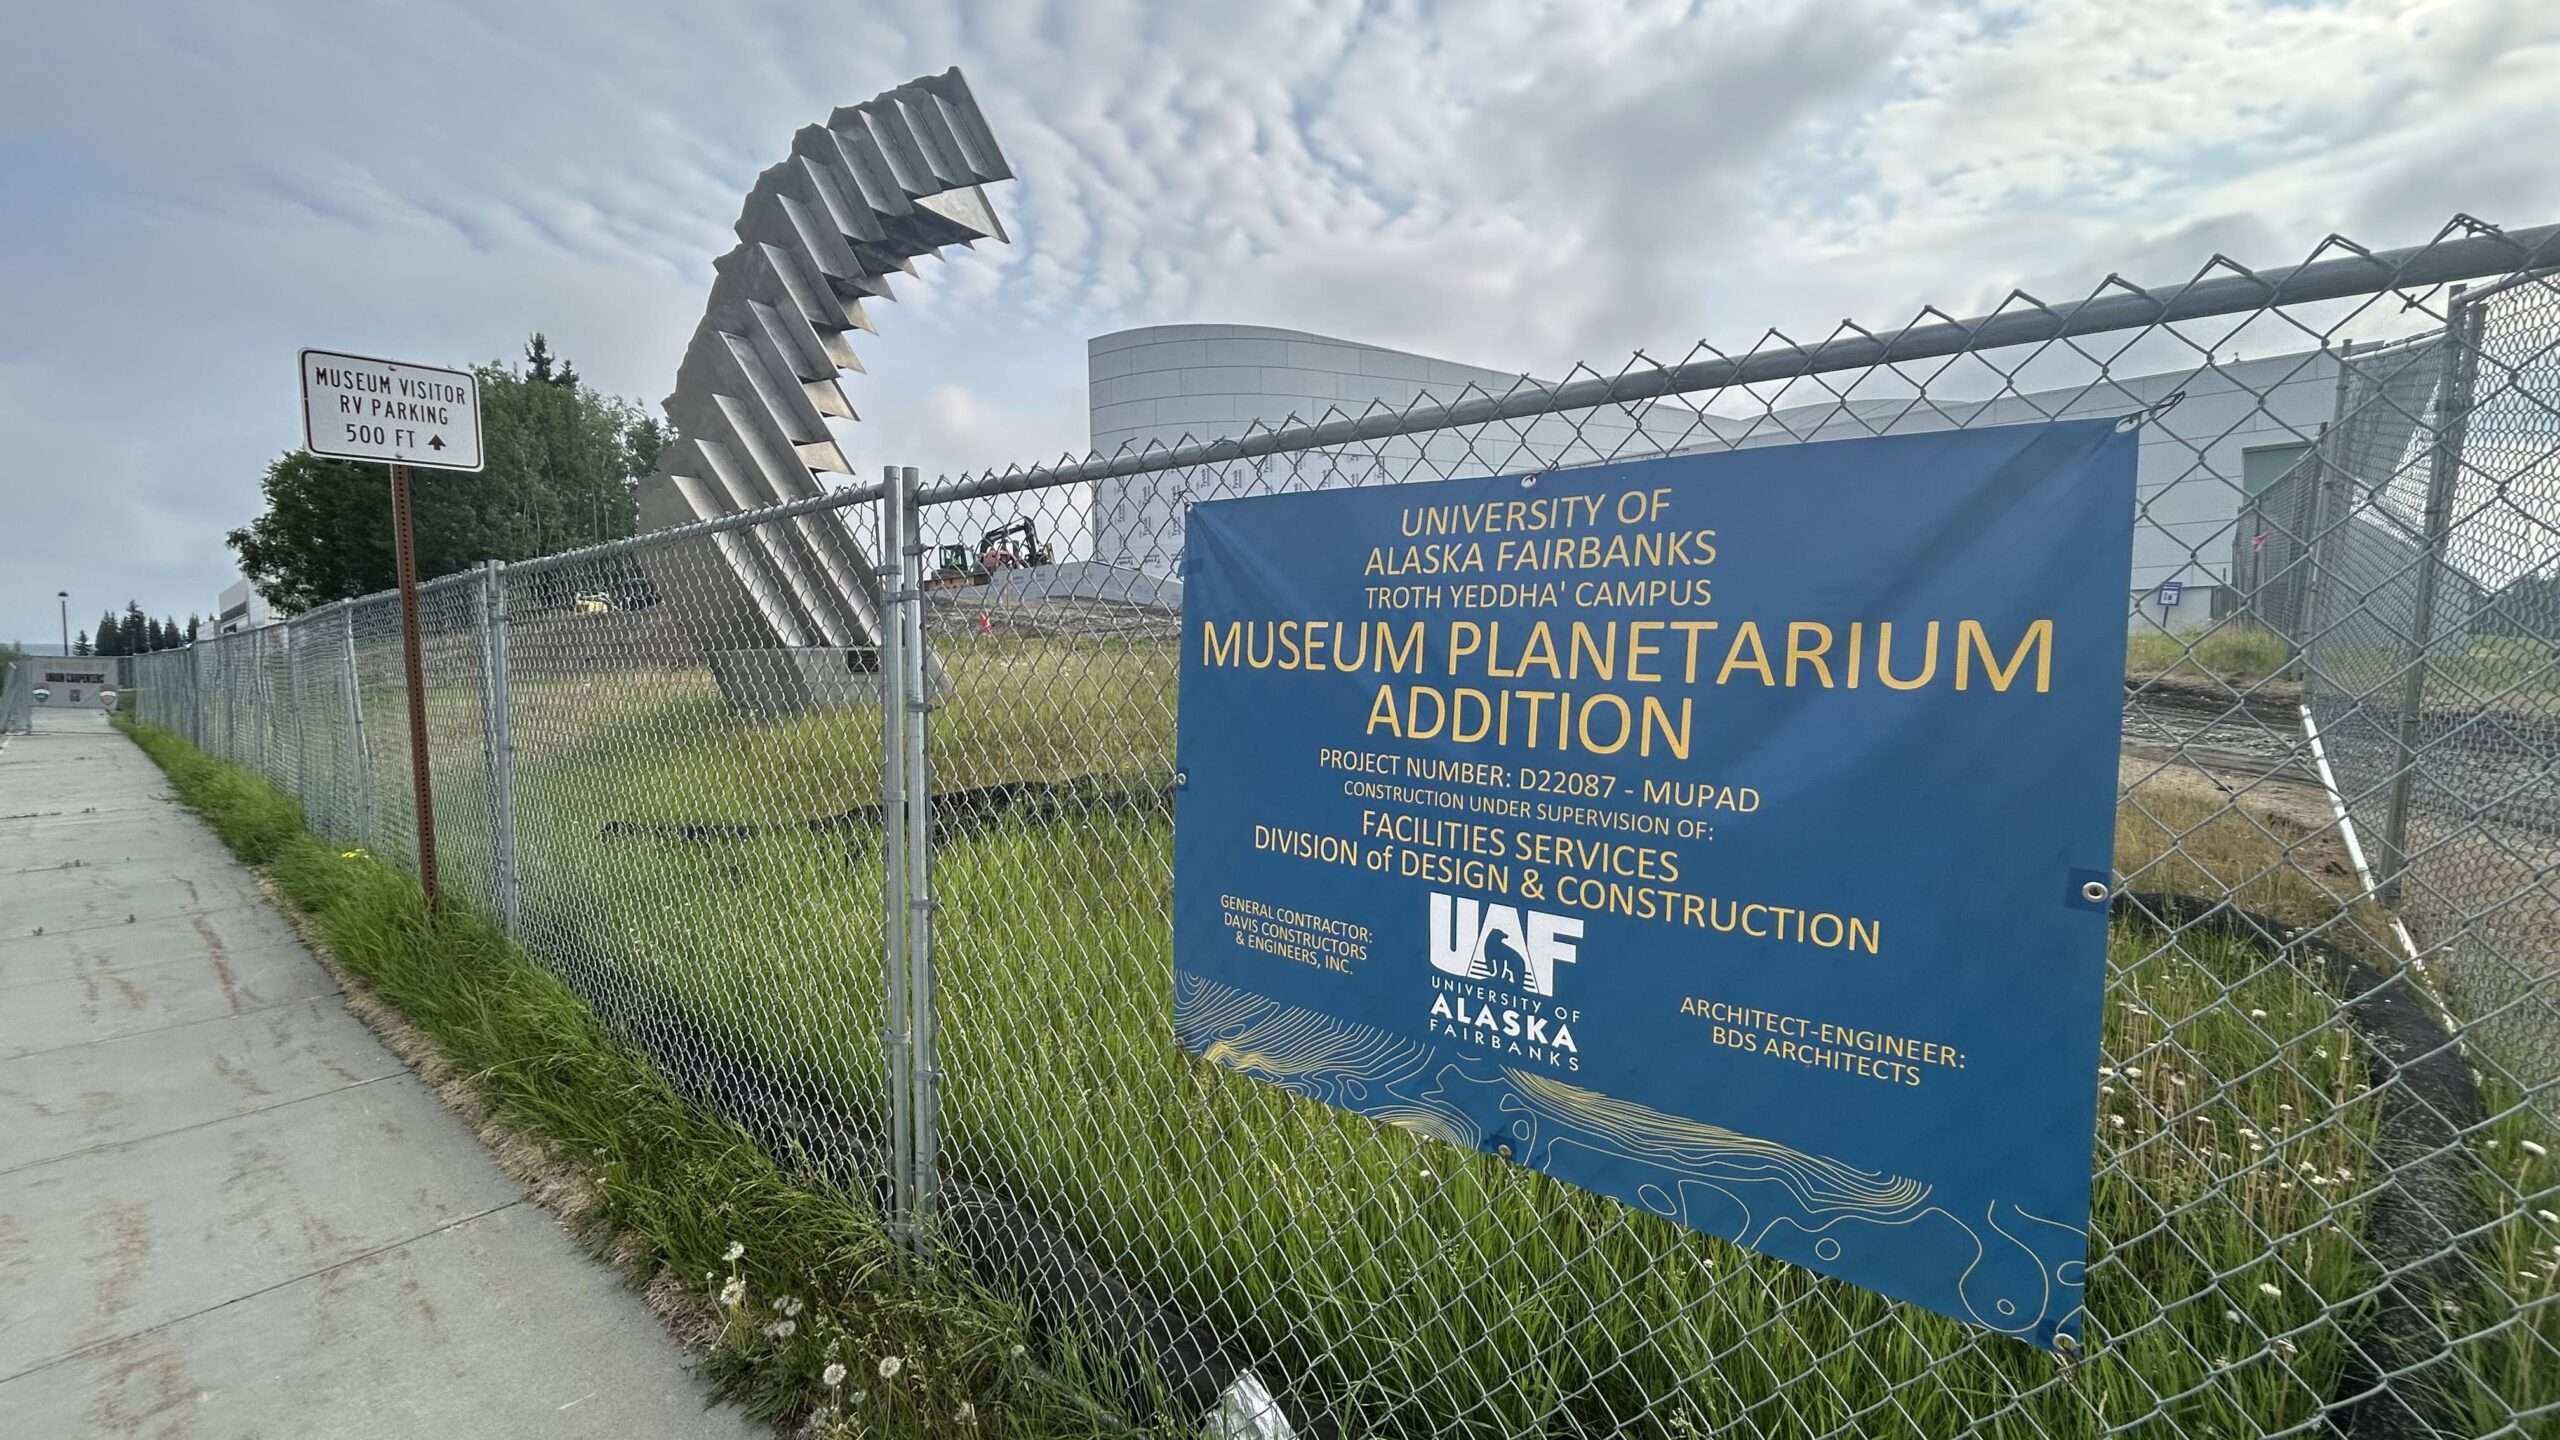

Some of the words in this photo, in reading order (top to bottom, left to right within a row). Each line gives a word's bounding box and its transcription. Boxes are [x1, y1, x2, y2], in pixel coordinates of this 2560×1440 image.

[315, 366, 391, 394] MUSEUM
[399, 379, 466, 405] VISITOR
[340, 395, 362, 415] RV
[372, 399, 448, 425] PARKING
[346, 423, 385, 445] 500
[396, 429, 416, 448] FT
[1402, 494, 1605, 537] UNIVERSITY
[1617, 488, 1672, 524] OF
[1364, 542, 1485, 576] ALASKA
[1497, 530, 1717, 571] FAIRBANKS
[1365, 586, 1440, 608] TROTH
[1450, 580, 1567, 608] YEDDHA'
[1575, 579, 1712, 606] CAMPUS
[1203, 621, 1425, 674] MUSEUM
[1449, 619, 2053, 693] PLANETARIUM
[1366, 684, 1692, 760] ADDITION
[1320, 748, 1400, 775] PROJECT
[1407, 757, 1511, 788] NUMBER:
[1520, 767, 1616, 799] D22087
[1643, 779, 1760, 813] MUPAD
[1344, 780, 1464, 810] CONSTRUCTION
[1470, 797, 1531, 819] UNDER
[1537, 805, 1669, 836] SUPERVISION
[1676, 818, 1713, 841] OF:
[1363, 810, 1506, 856] FACILITIES
[1515, 831, 1679, 883] SERVICES
[1255, 825, 1358, 866] DIVISION
[1367, 846, 1393, 872] of
[1401, 849, 1509, 894] DESIGN
[1521, 869, 1545, 900] &
[1557, 876, 1880, 954] CONSTRUCTION
[1220, 894, 1274, 919] GENERAL
[1276, 908, 1373, 943] CONTRACTOR:
[1224, 912, 1258, 933] DAVIS
[1262, 922, 1367, 960] CONSTRUCTORS
[1430, 892, 1584, 997] UAF
[1235, 931, 1245, 945] &
[1248, 934, 1321, 969] ENGINEERS,
[1325, 954, 1353, 975] INC.
[1431, 976, 1541, 1013] UNIVERSITY
[1554, 1007, 1580, 1023] OF
[1431, 992, 1577, 1053] ALASKA
[1431, 1018, 1579, 1071] FAIRBANKS
[1680, 997, 1966, 1069] ARCHITECT-ENGINEER:
[1712, 1026, 1757, 1051] BDS
[1763, 1038, 1921, 1086] ARCHITECTS
